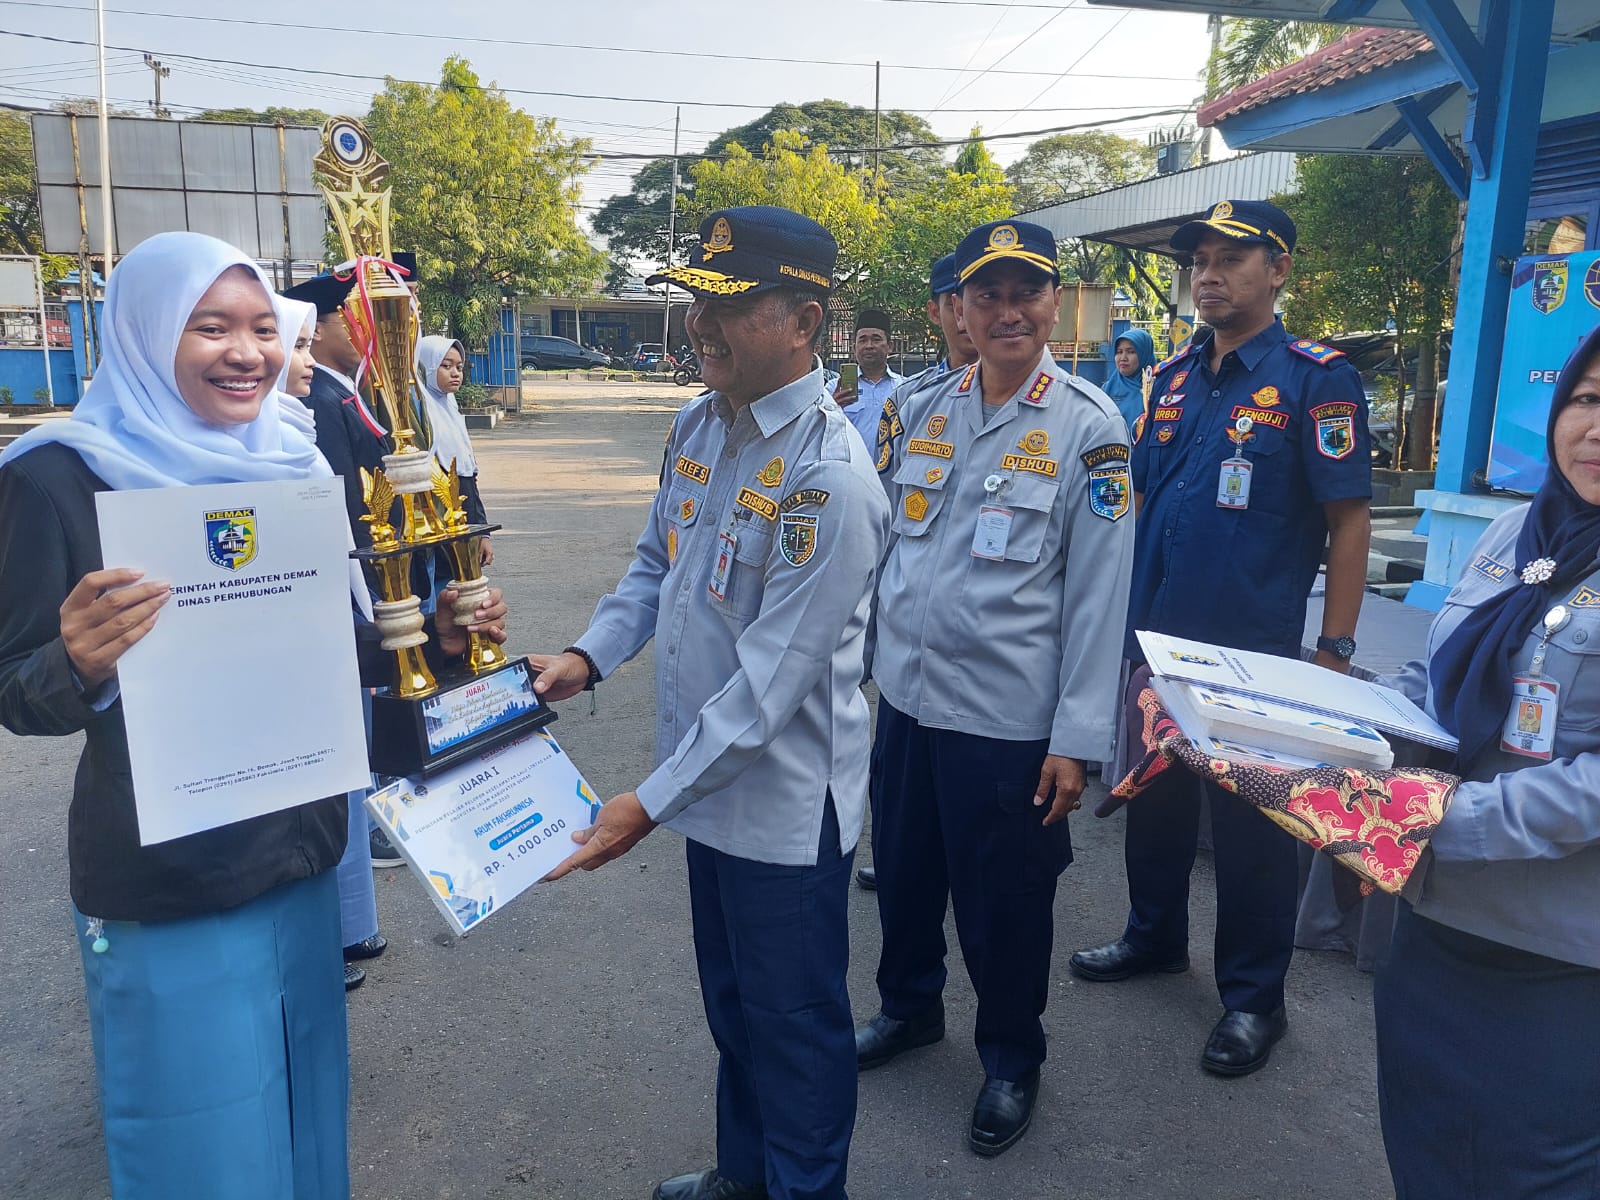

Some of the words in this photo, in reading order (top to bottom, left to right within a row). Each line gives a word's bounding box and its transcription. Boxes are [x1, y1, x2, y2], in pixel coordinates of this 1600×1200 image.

[1536, 262, 1567, 270] DEMAK
[1237, 409, 1283, 426] PENGUJI
[910, 441, 951, 456] SUGIHARTO
[1006, 456, 1056, 473] DISHUB
[743, 492, 774, 517] DISHUB
[206, 509, 252, 520] DEMAK
[170, 582, 216, 595] ERINTAH
[220, 573, 281, 589] KABUPATEN
[283, 568, 318, 581] DEMAK
[177, 596, 211, 608] DINAS
[214, 585, 293, 603] PERHUBUNGAN
[465, 683, 486, 698] JUARA
[183, 780, 203, 789] Sultan
[458, 770, 493, 795] JUARA
[491, 766, 500, 776] I
[473, 820, 495, 838] ARUM
[484, 860, 505, 877] RP.
[507, 818, 566, 862] 1.000.000
